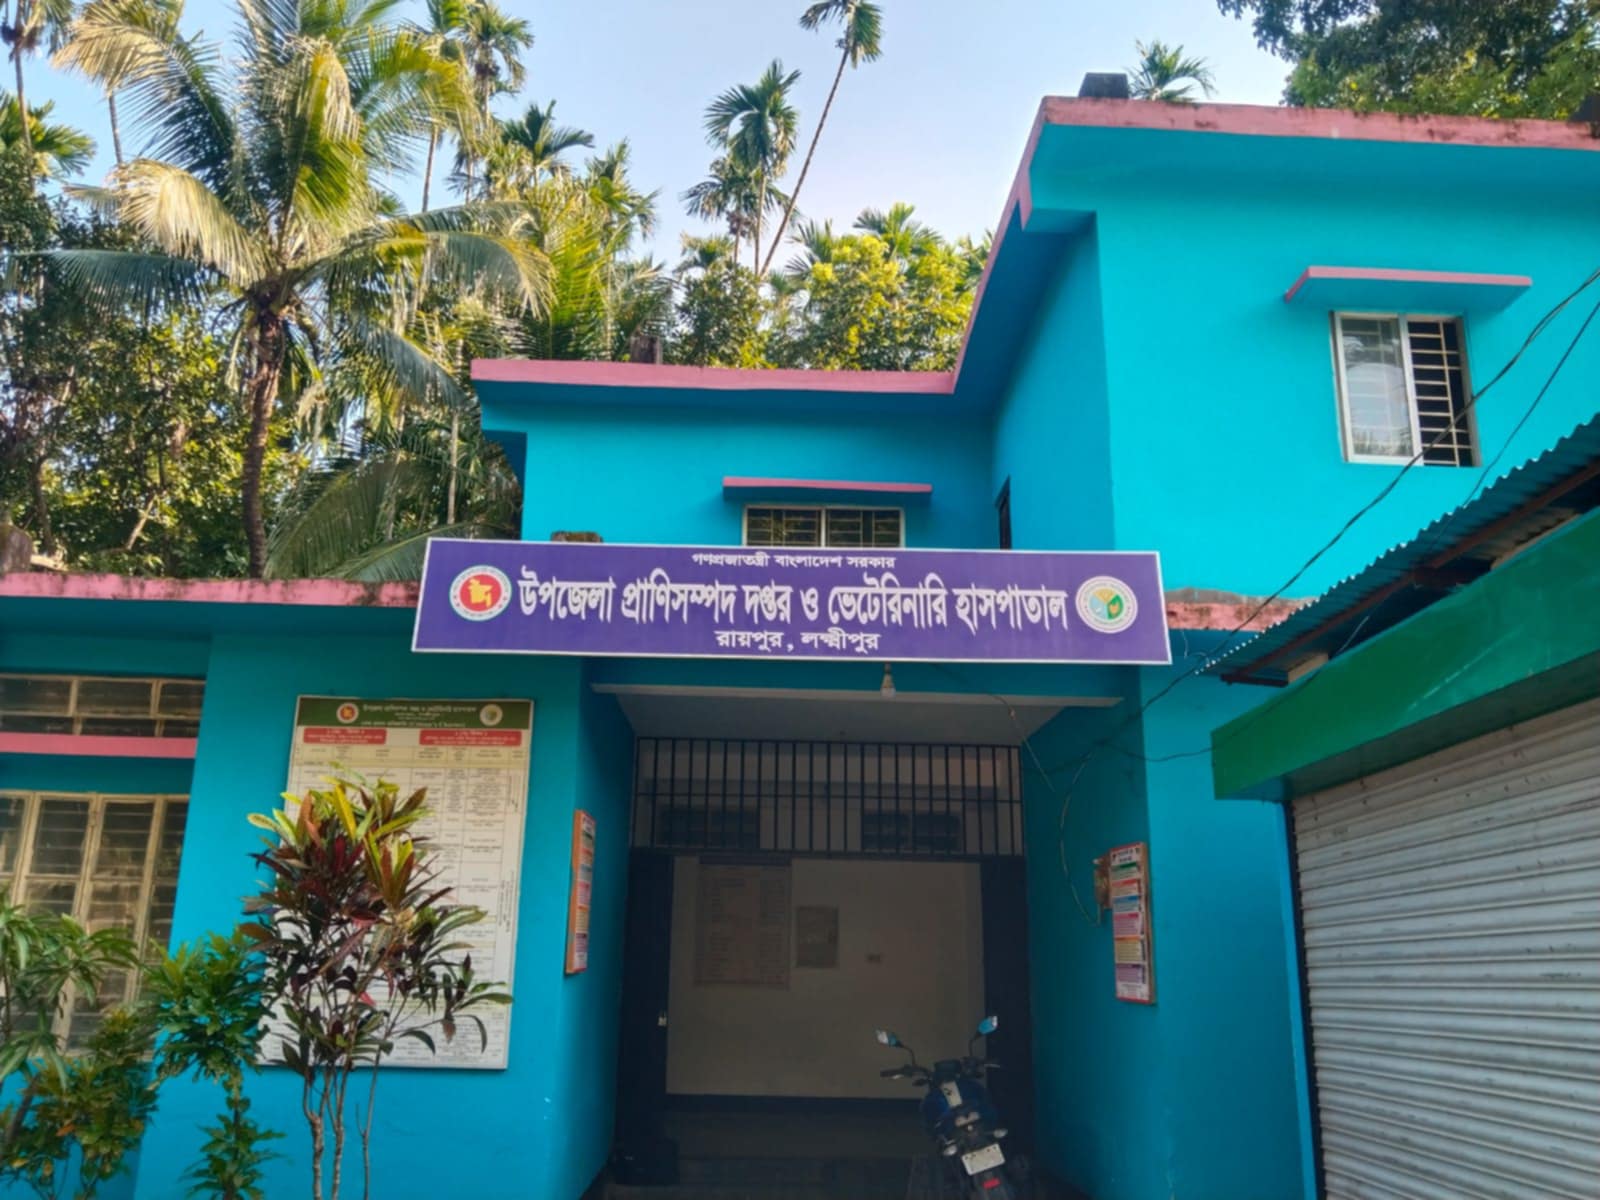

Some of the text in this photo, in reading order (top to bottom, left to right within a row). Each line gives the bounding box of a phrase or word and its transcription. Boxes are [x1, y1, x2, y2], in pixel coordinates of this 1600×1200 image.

[774, 554, 843, 568] বাংলাদেশ
[847, 556, 897, 569] সরকার
[519, 565, 616, 622] উপজেলা
[621, 567, 738, 624] প্রাণিসম্পদ
[742, 578, 793, 625] দপ্তর
[799, 587, 819, 621] ও
[827, 571, 948, 629] ভেটেরিনারি
[953, 583, 1069, 635] হাসপাতাল
